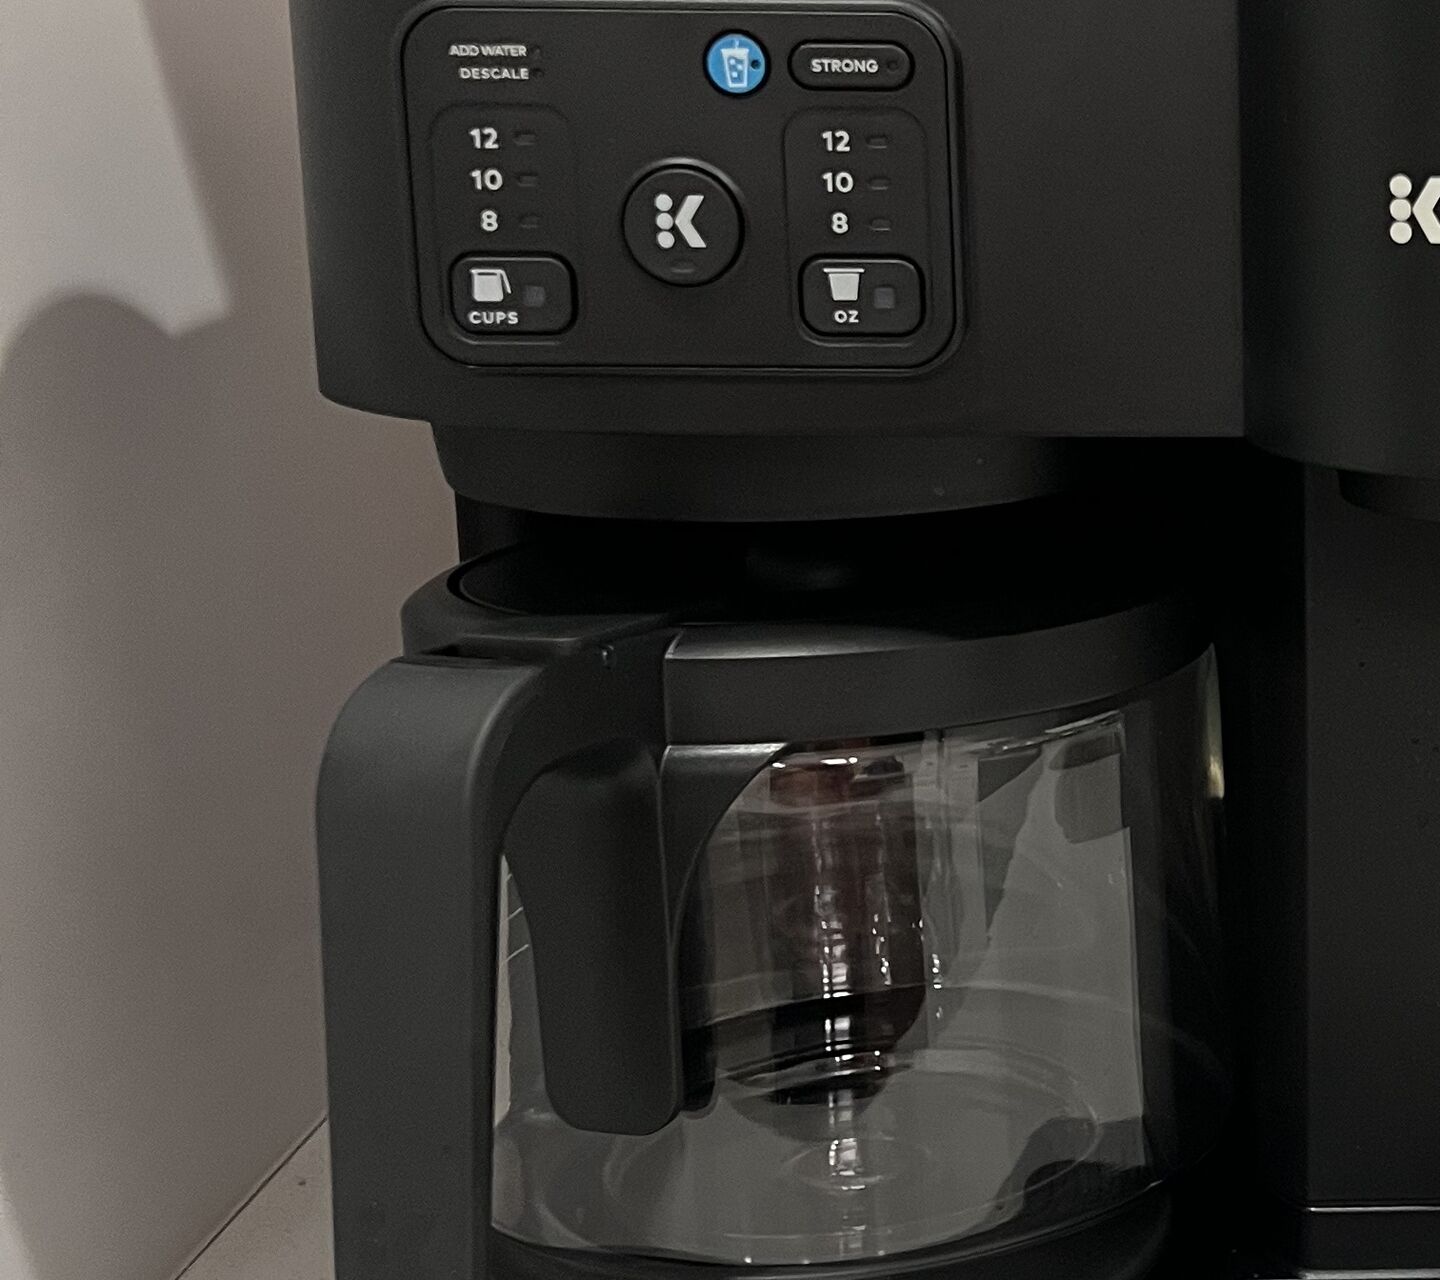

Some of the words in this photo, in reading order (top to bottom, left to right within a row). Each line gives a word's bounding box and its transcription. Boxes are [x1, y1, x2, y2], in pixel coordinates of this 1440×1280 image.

[449, 45, 480, 57] ADD
[481, 45, 527, 57] WATER
[459, 67, 529, 80] DESCALE
[810, 58, 879, 73] STRONG
[469, 127, 499, 150] 12
[822, 130, 851, 153] 12
[470, 169, 503, 191] 10
[823, 172, 854, 193] 10
[480, 210, 499, 232] 8
[831, 212, 849, 234] 8
[469, 311, 519, 325] CUPS
[833, 310, 860, 324] OZ
